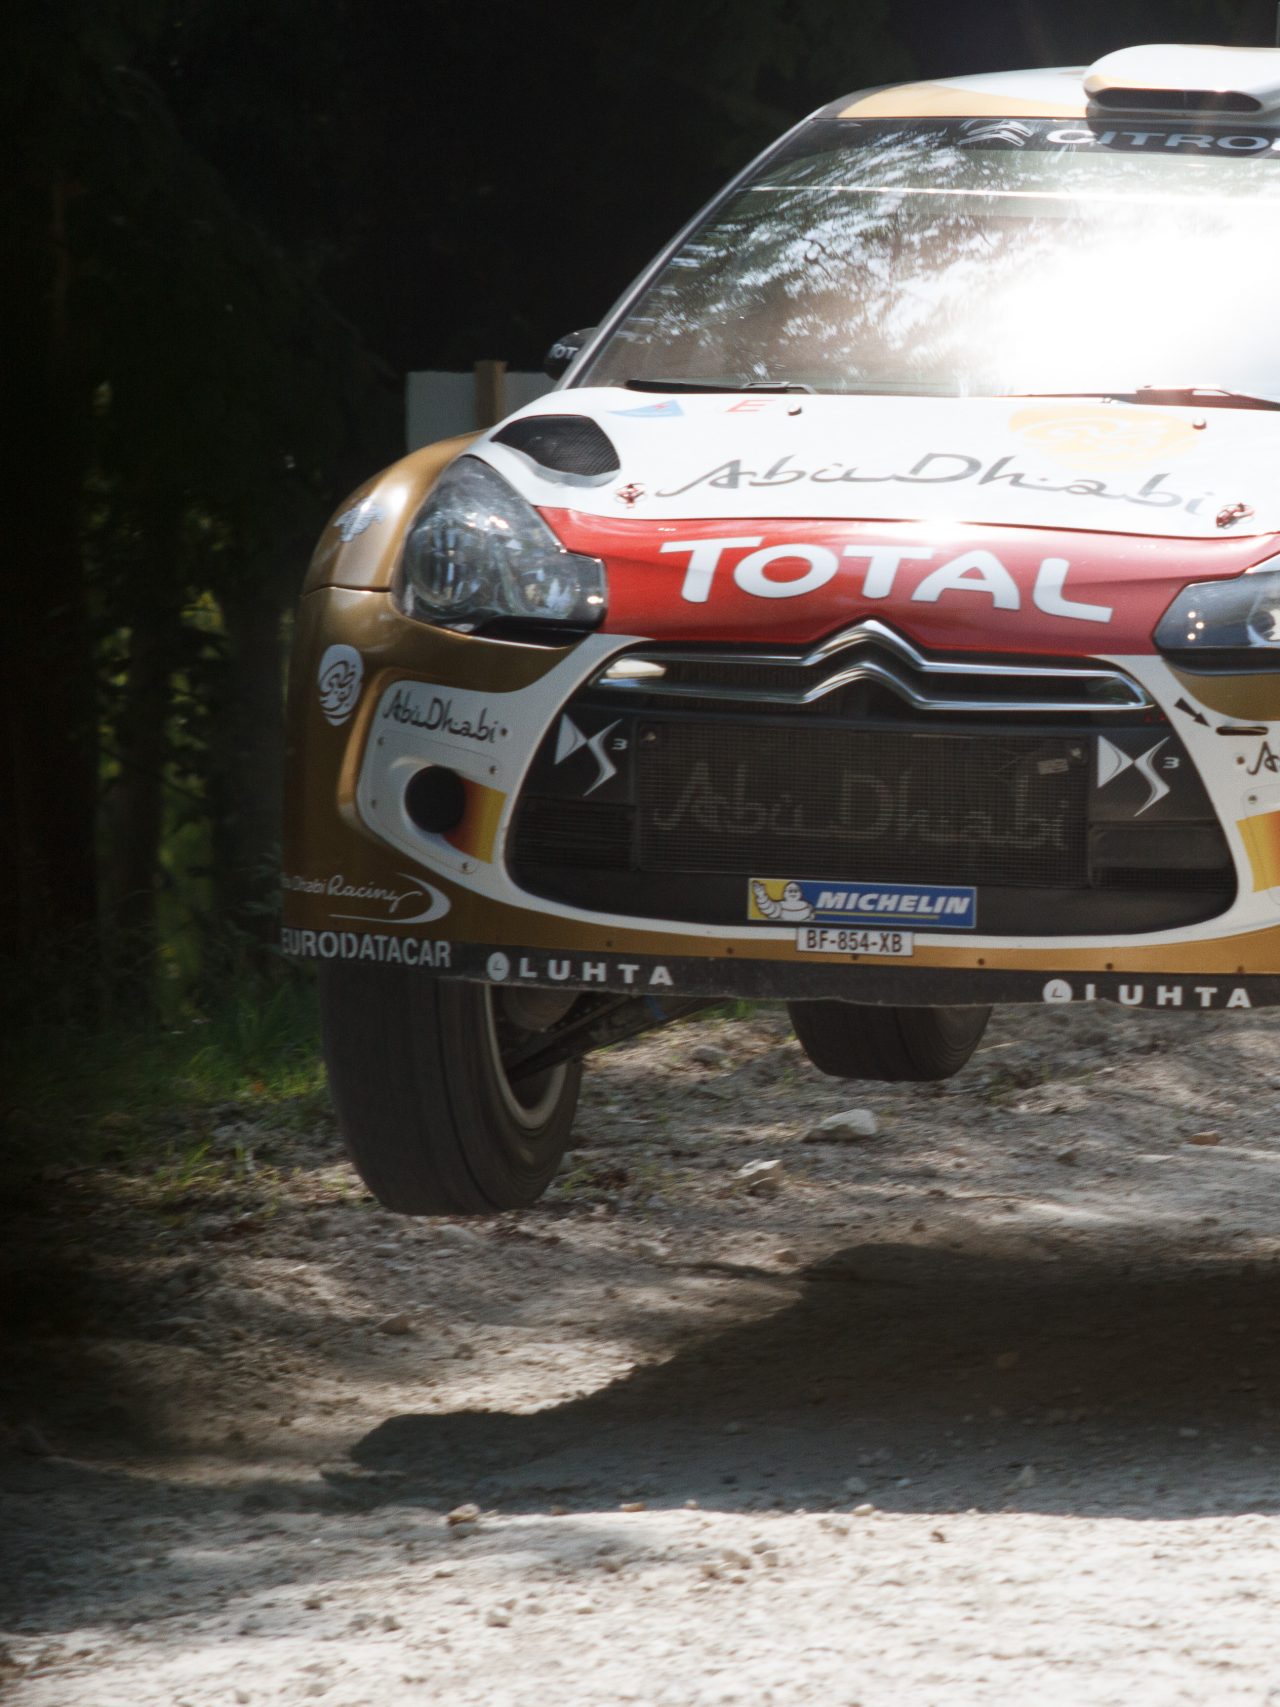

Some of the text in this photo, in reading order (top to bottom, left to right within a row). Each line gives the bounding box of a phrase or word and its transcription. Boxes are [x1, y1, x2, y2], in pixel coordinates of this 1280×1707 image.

[659, 536, 1113, 623] TOTAL
[327, 875, 424, 914] Racing
[815, 890, 971, 915] MICHELIN
[281, 927, 452, 968] EURODATACAR
[806, 929, 902, 953] BF-854-XB
[518, 956, 674, 986] LUHTA
[1085, 983, 1253, 1008] LUHTA
